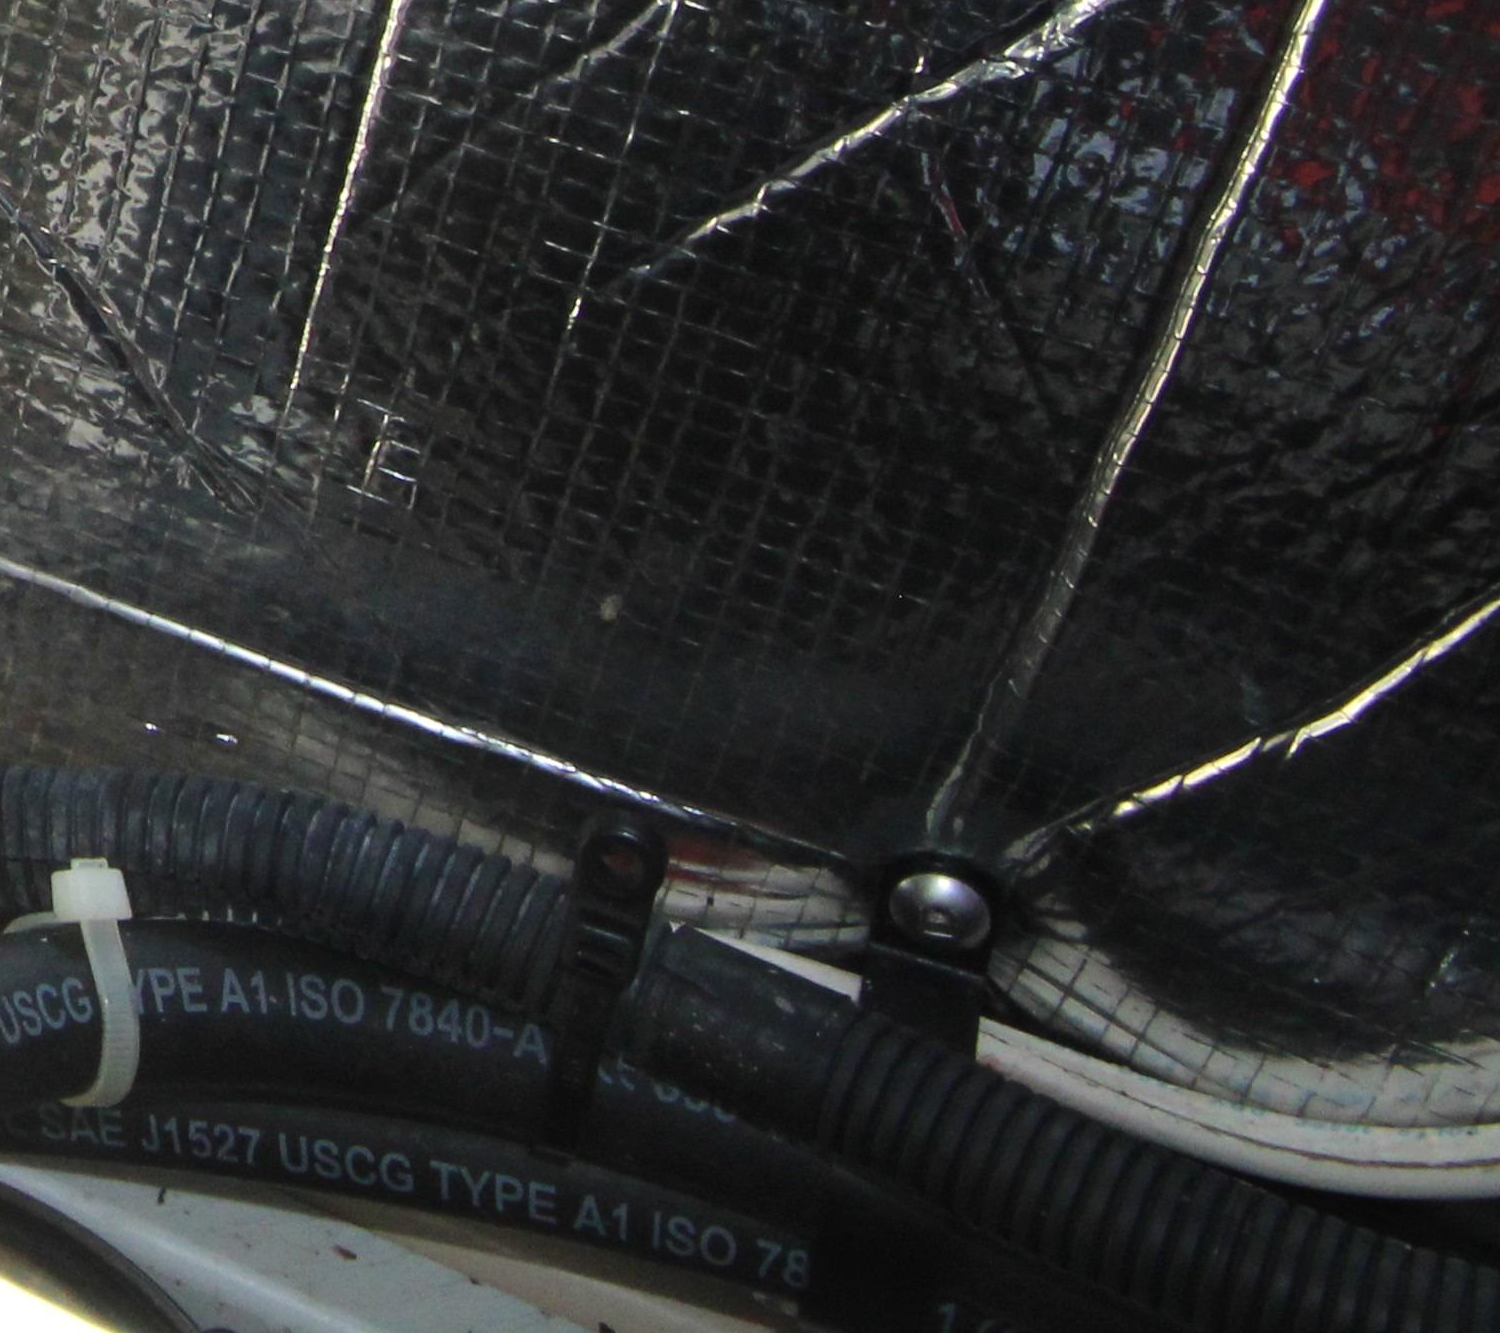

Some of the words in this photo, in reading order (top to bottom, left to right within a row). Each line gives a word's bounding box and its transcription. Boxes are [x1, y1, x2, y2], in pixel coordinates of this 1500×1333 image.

[128, 966, 205, 1016] YPE
[219, 968, 269, 1017] A1
[285, 971, 367, 1026] ISO
[380, 984, 550, 1068] 7840-A
[39, 1103, 126, 1148] SAE
[141, 1113, 262, 1168] J1527
[277, 1131, 417, 1195] USCG
[428, 1158, 560, 1225] TYPE
[572, 1193, 631, 1243] A1
[651, 1211, 738, 1268] ISO
[756, 1236, 811, 1289] 78
